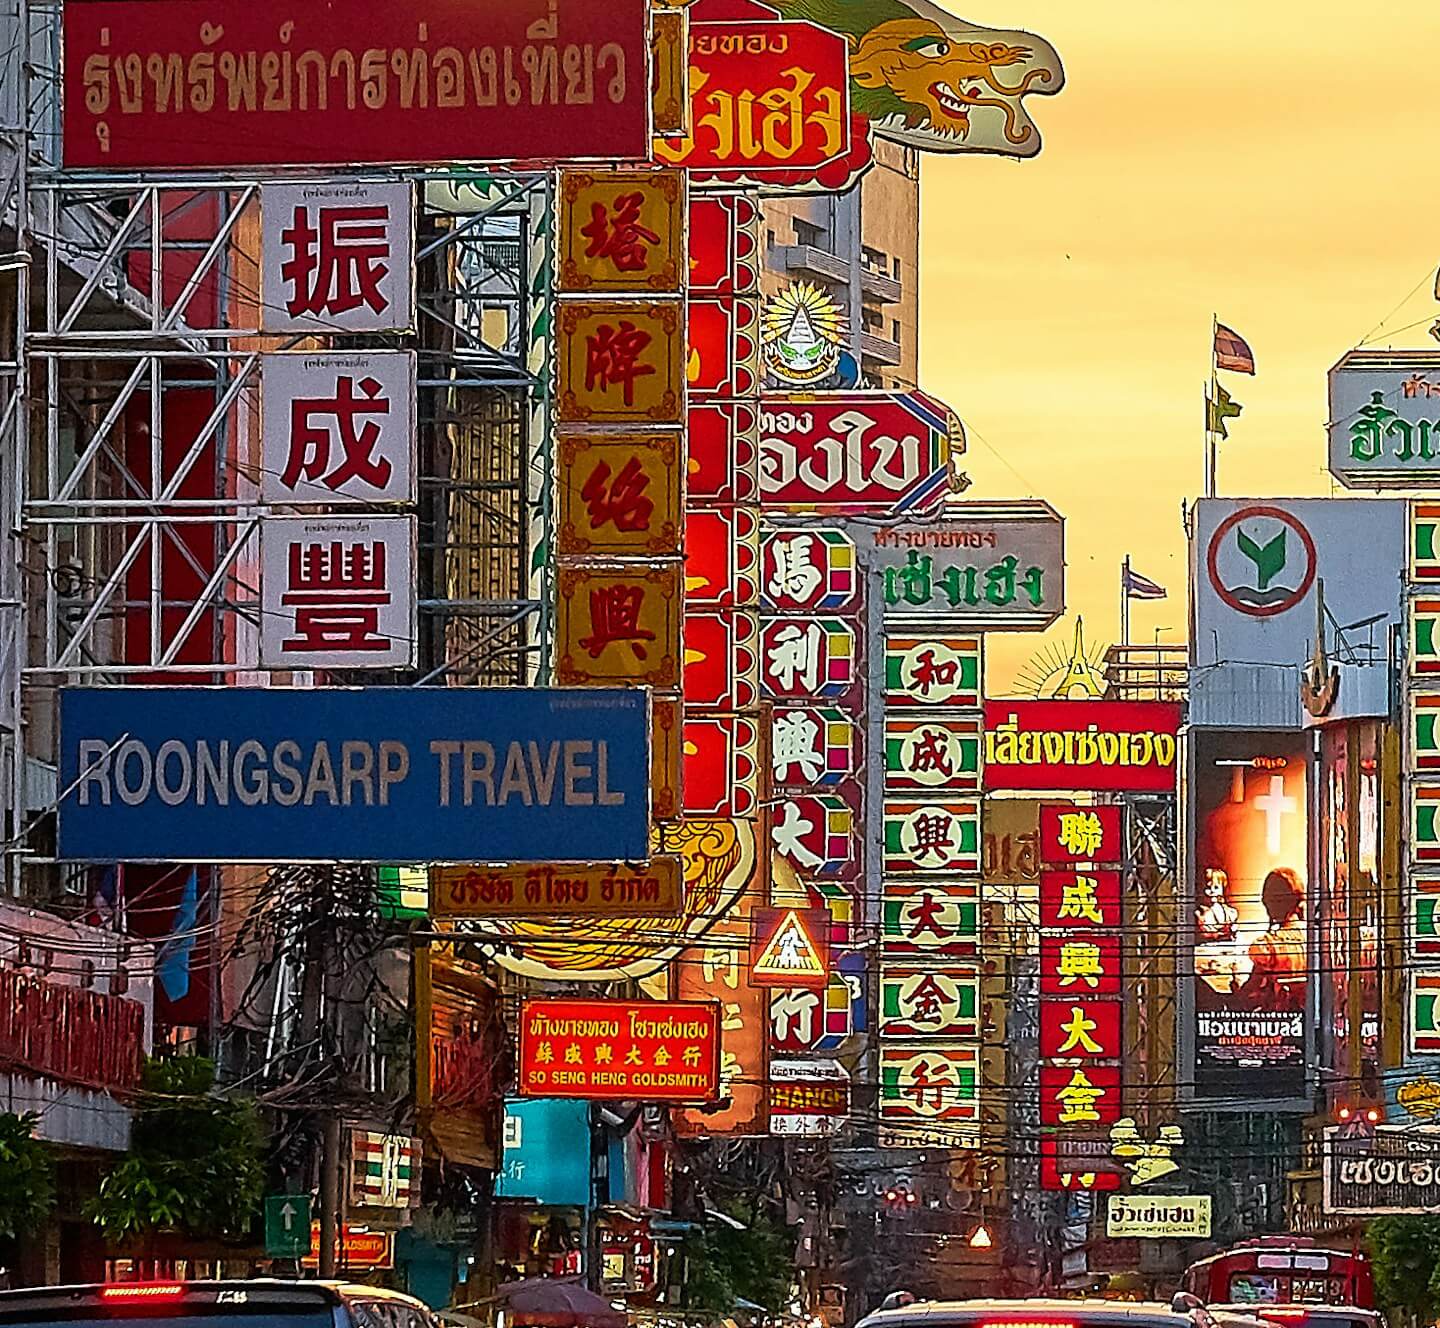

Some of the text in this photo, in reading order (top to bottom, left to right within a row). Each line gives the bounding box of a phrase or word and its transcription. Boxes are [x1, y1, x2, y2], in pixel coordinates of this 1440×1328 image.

[83, 3, 626, 153] รุ่งทรัพย์การท่องเที่ยว
[79, 740, 625, 807] ROONGSARP TRAVEL
[529, 1072, 707, 1087] SO SENG HENG GOLDSMITH
